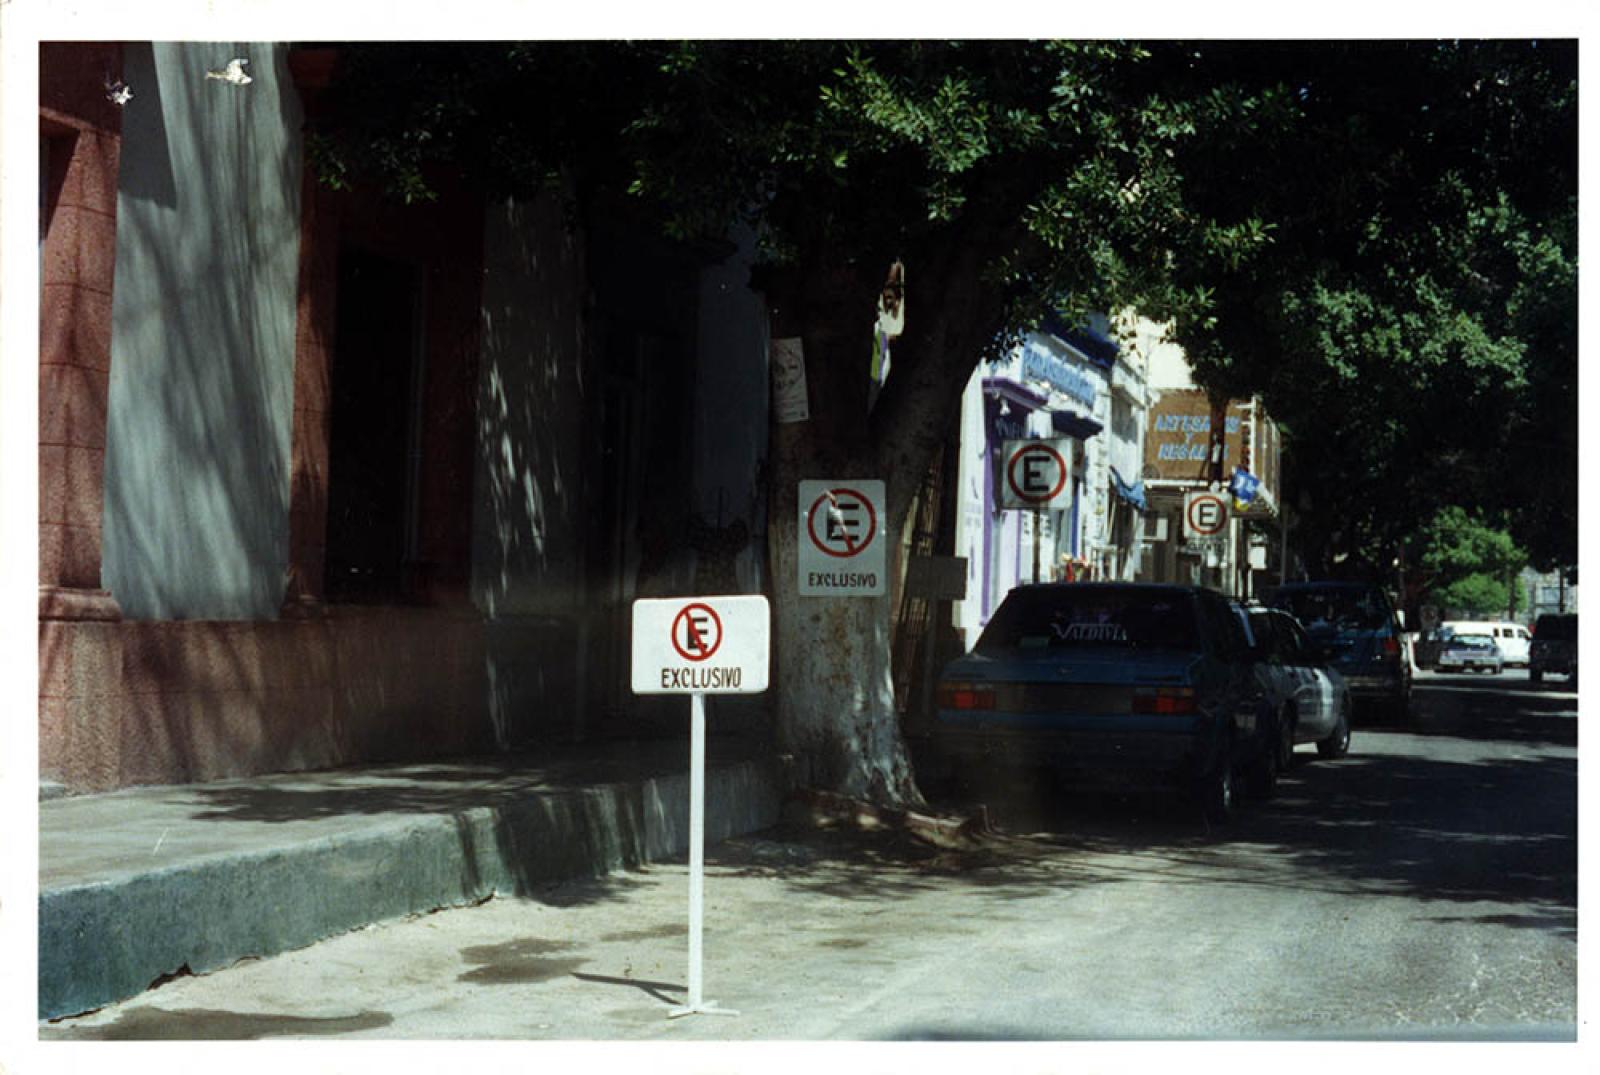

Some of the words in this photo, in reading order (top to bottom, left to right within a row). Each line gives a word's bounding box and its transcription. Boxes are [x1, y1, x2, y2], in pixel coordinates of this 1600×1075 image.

[1023, 455, 1051, 492] E
[826, 503, 860, 541] E
[1199, 503, 1217, 527] E
[808, 572, 877, 588] EXCLUSIVO
[687, 617, 708, 650] E
[661, 667, 742, 688] EXCLUSIVO
